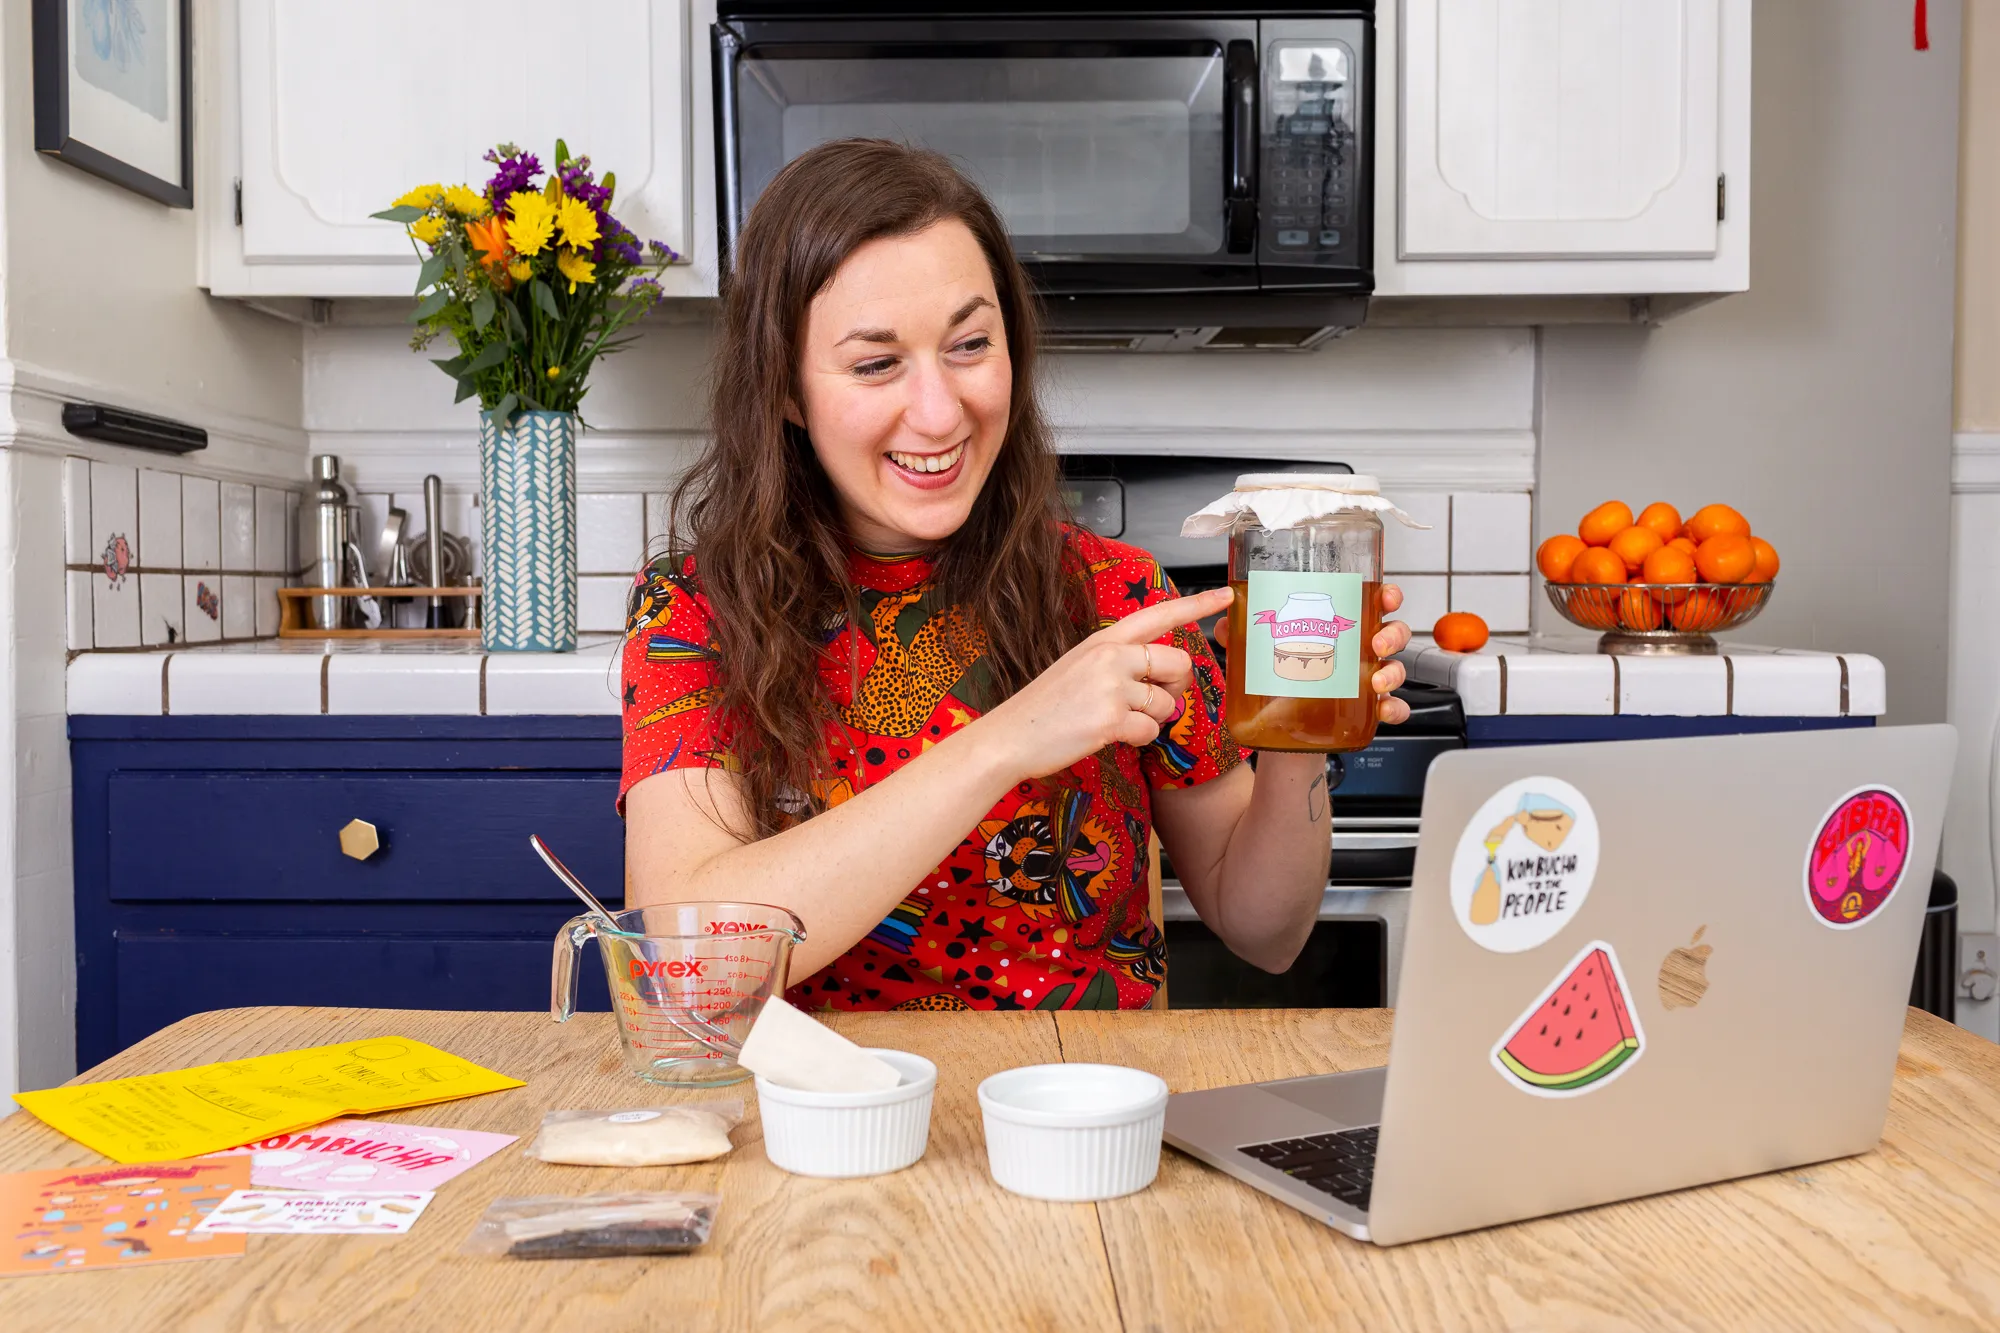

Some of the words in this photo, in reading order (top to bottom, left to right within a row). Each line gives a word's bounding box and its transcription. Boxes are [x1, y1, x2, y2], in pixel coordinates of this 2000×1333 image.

[1275, 620, 1338, 636] KOMBUCHA
[1817, 798, 1901, 872] LIBRA
[1507, 855, 1576, 881] KOMBUCHA
[1528, 881, 1541, 890] TO
[1545, 879, 1562, 889] THE
[1503, 891, 1566, 919] PEOPLE
[713, 987, 732, 996] 250
[713, 1001, 731, 1010] 200
[714, 1017, 730, 1025] 150
[714, 1034, 729, 1042] 100
[712, 1051, 723, 1059] 50
